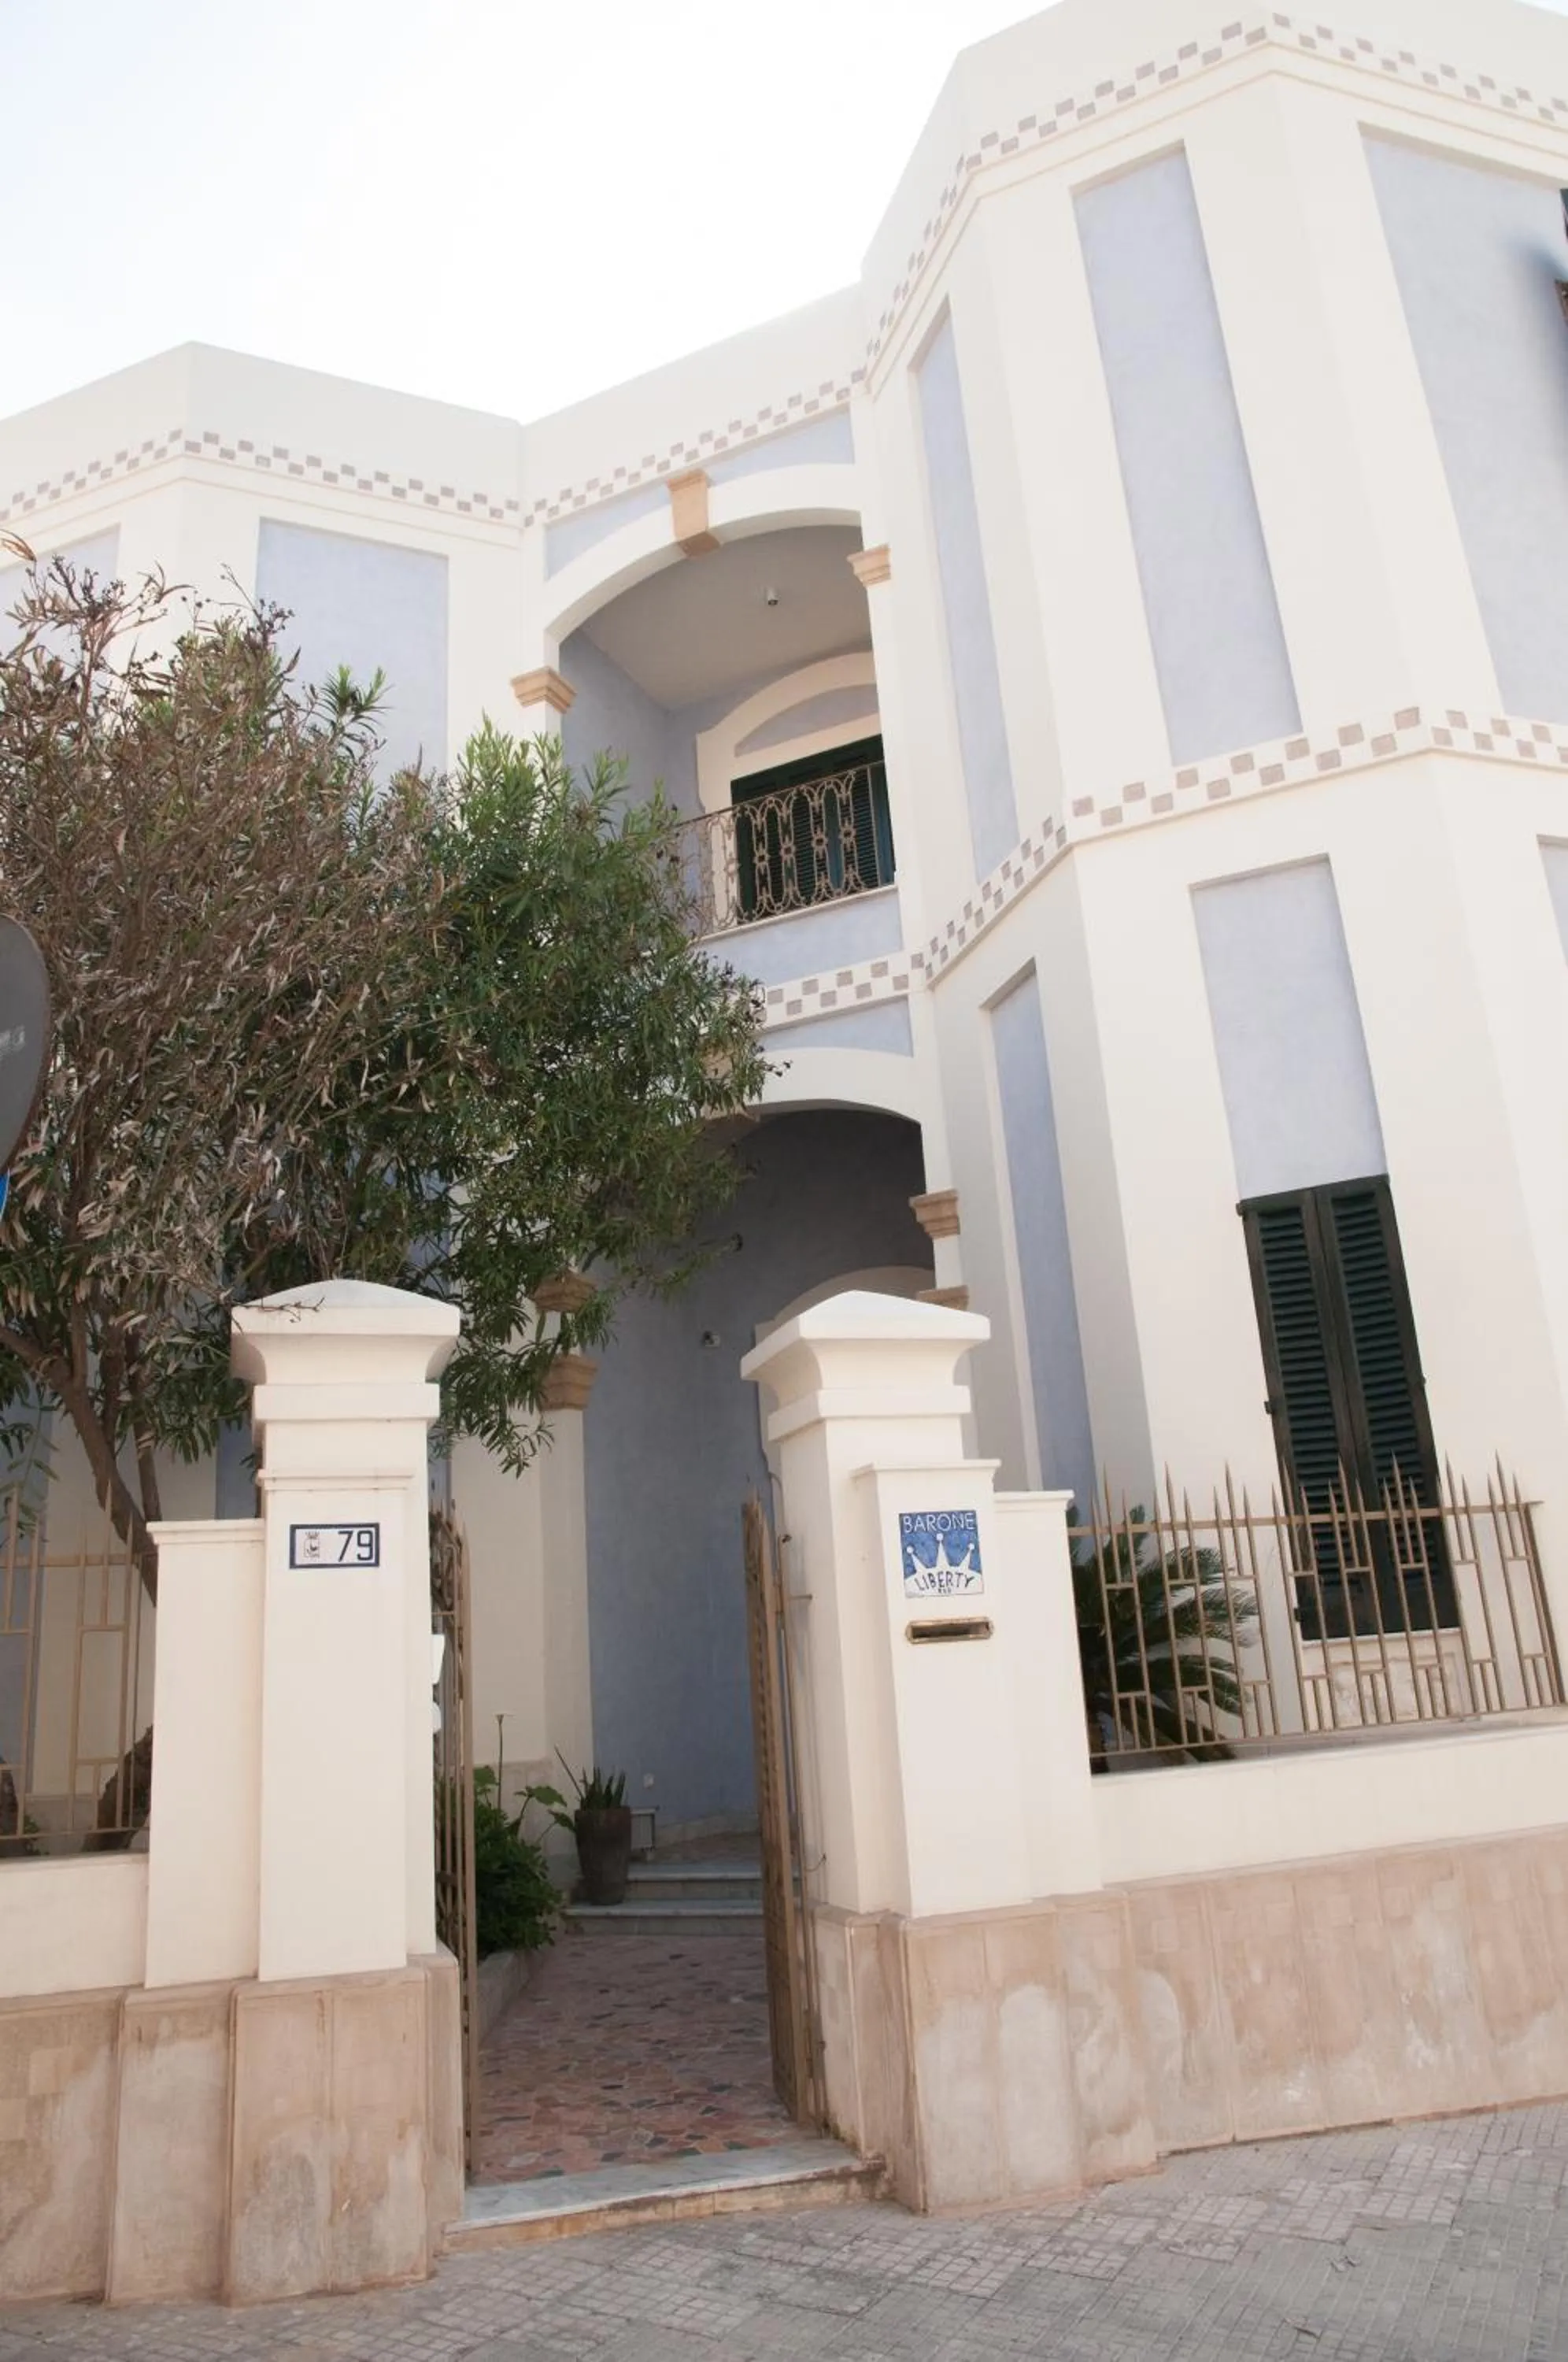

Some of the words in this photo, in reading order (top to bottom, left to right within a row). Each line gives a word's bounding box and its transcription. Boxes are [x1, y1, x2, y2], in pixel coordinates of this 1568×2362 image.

[903, 1512, 975, 1533] BARONE
[338, 1530, 373, 1562] 79
[914, 1571, 975, 1590] LIBERTY
